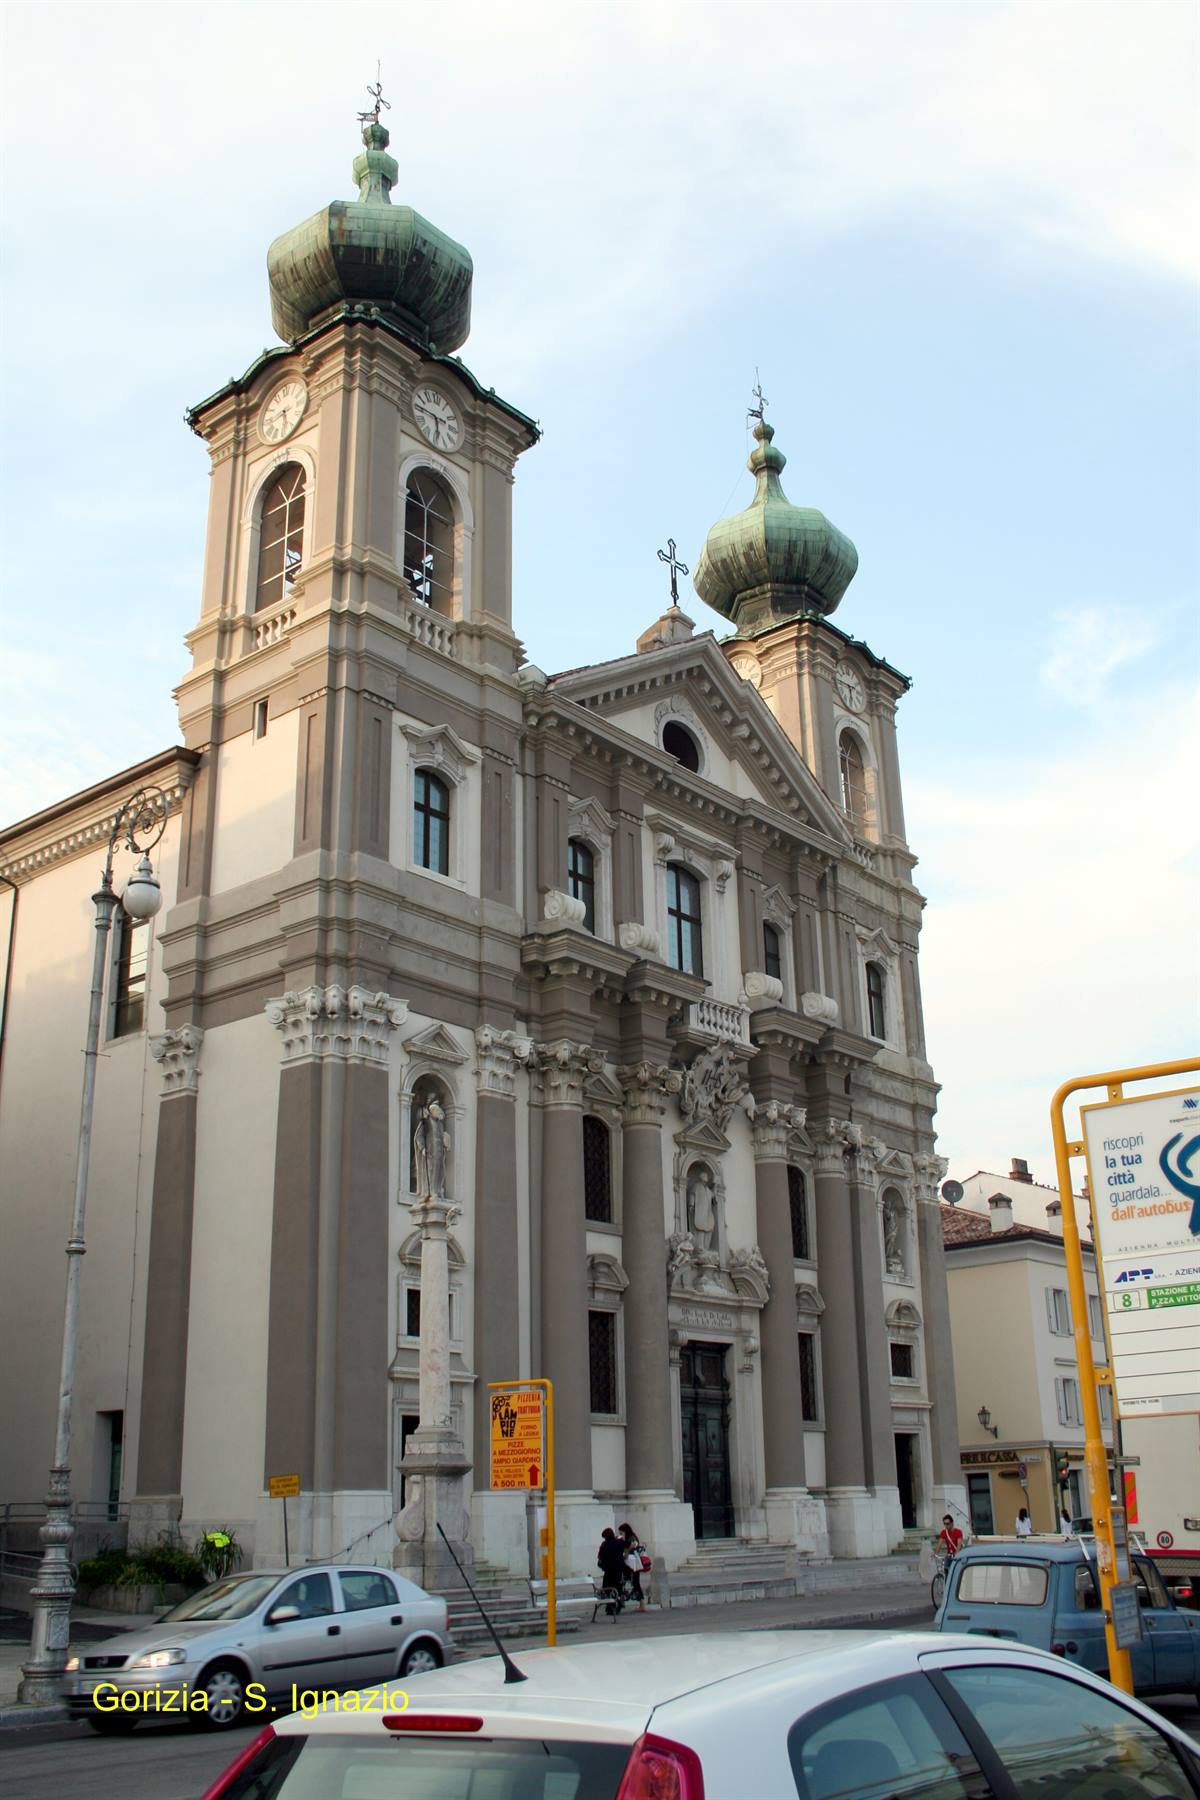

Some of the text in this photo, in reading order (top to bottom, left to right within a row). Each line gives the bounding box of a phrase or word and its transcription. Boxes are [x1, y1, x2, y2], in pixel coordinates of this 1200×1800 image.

[1103, 1132, 1144, 1151] riscopri
[1105, 1153, 1143, 1169] la tua
[1107, 1170, 1135, 1186] città
[1109, 1184, 1172, 1208] guardala...
[1111, 1200, 1191, 1221] dall'autobus
[1114, 1268, 1154, 1284] APT
[1151, 1286, 1188, 1297] STAZIONE
[1122, 1293, 1132, 1308] 8
[1151, 1296, 1174, 1306] P.ZZA
[517, 1393, 540, 1402] PIZZERIA
[499, 1407, 517, 1420] LAM
[517, 1405, 540, 1414] TRATTORIA
[500, 1420, 516, 1430] PIO
[502, 1429, 514, 1438] NE
[507, 1440, 524, 1448] PIZZE
[498, 1447, 541, 1456] MEZZOGIORNO
[512, 1456, 541, 1464] GIARDINO
